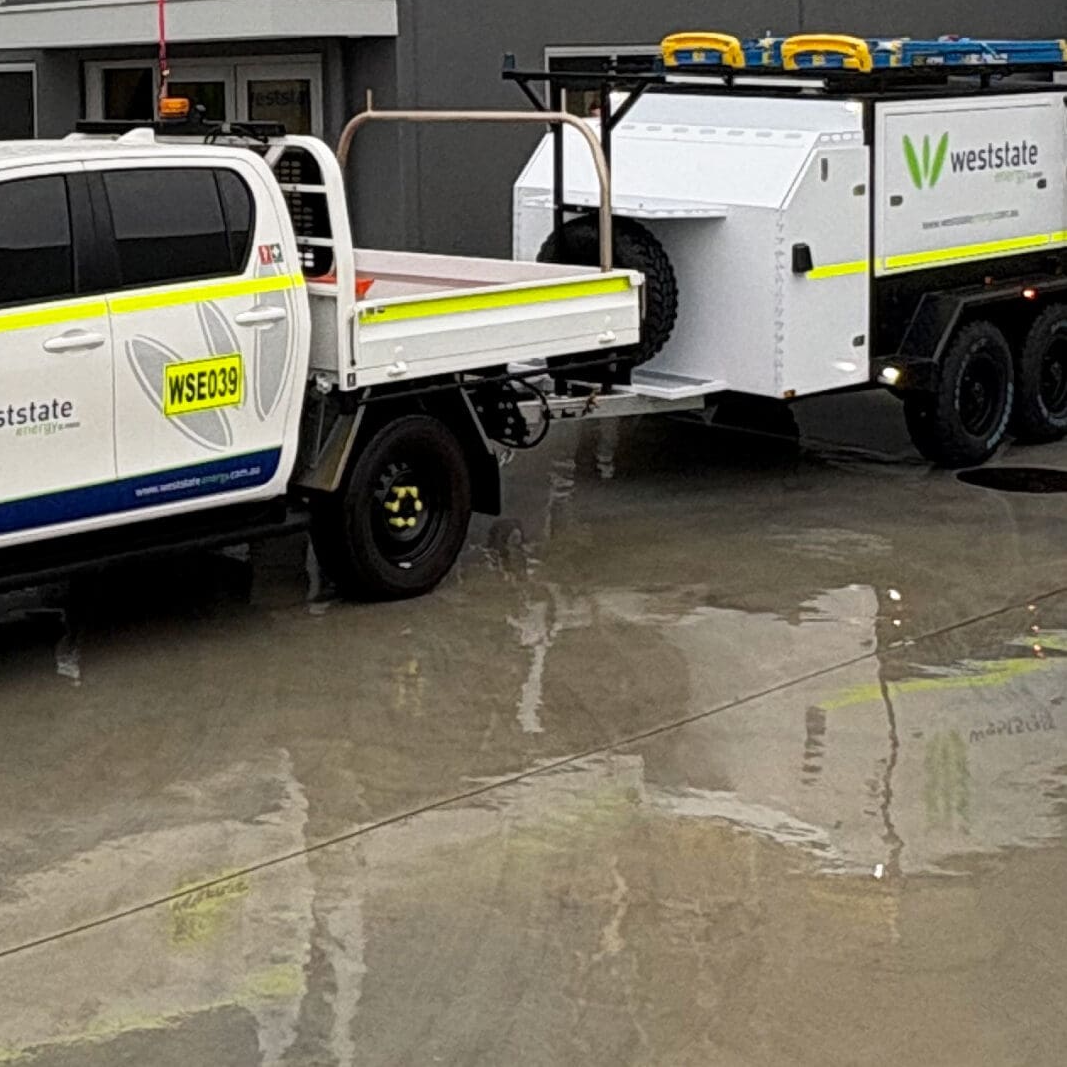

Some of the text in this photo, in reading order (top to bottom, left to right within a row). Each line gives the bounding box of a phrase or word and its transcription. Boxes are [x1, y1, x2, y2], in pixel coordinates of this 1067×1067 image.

[950, 139, 1039, 173] weststate
[168, 366, 239, 405] WSE039
[15, 421, 58, 437] energy
